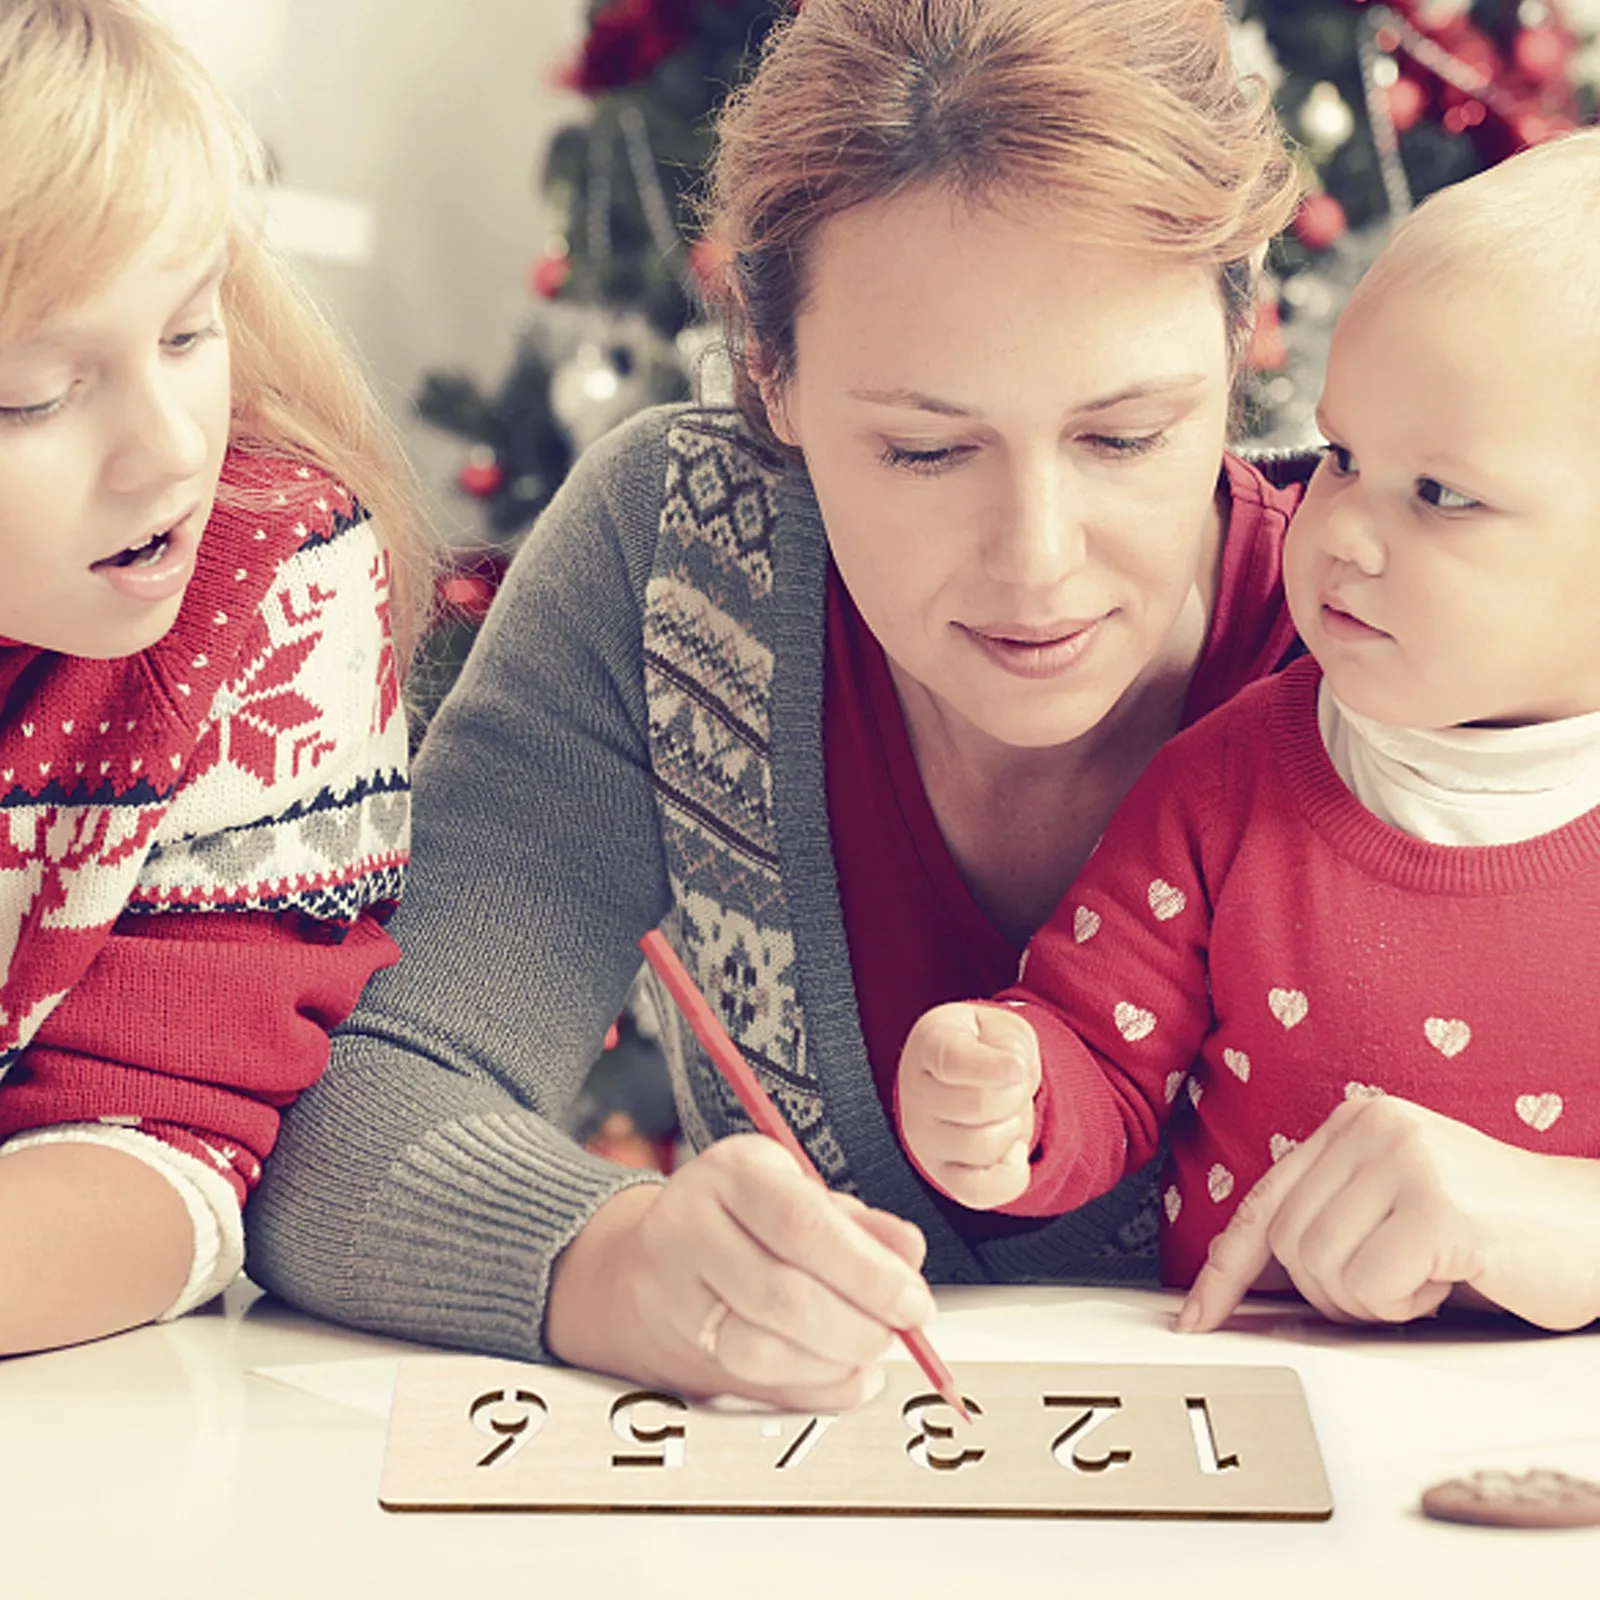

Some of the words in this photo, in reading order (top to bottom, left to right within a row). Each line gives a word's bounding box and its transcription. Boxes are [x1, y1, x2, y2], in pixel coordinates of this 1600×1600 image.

[467, 1389, 549, 1467] 6
[609, 1390, 688, 1467] 5
[901, 1393, 986, 1472] 3
[1042, 1396, 1132, 1472] 2
[1184, 1397, 1239, 1473] 1
